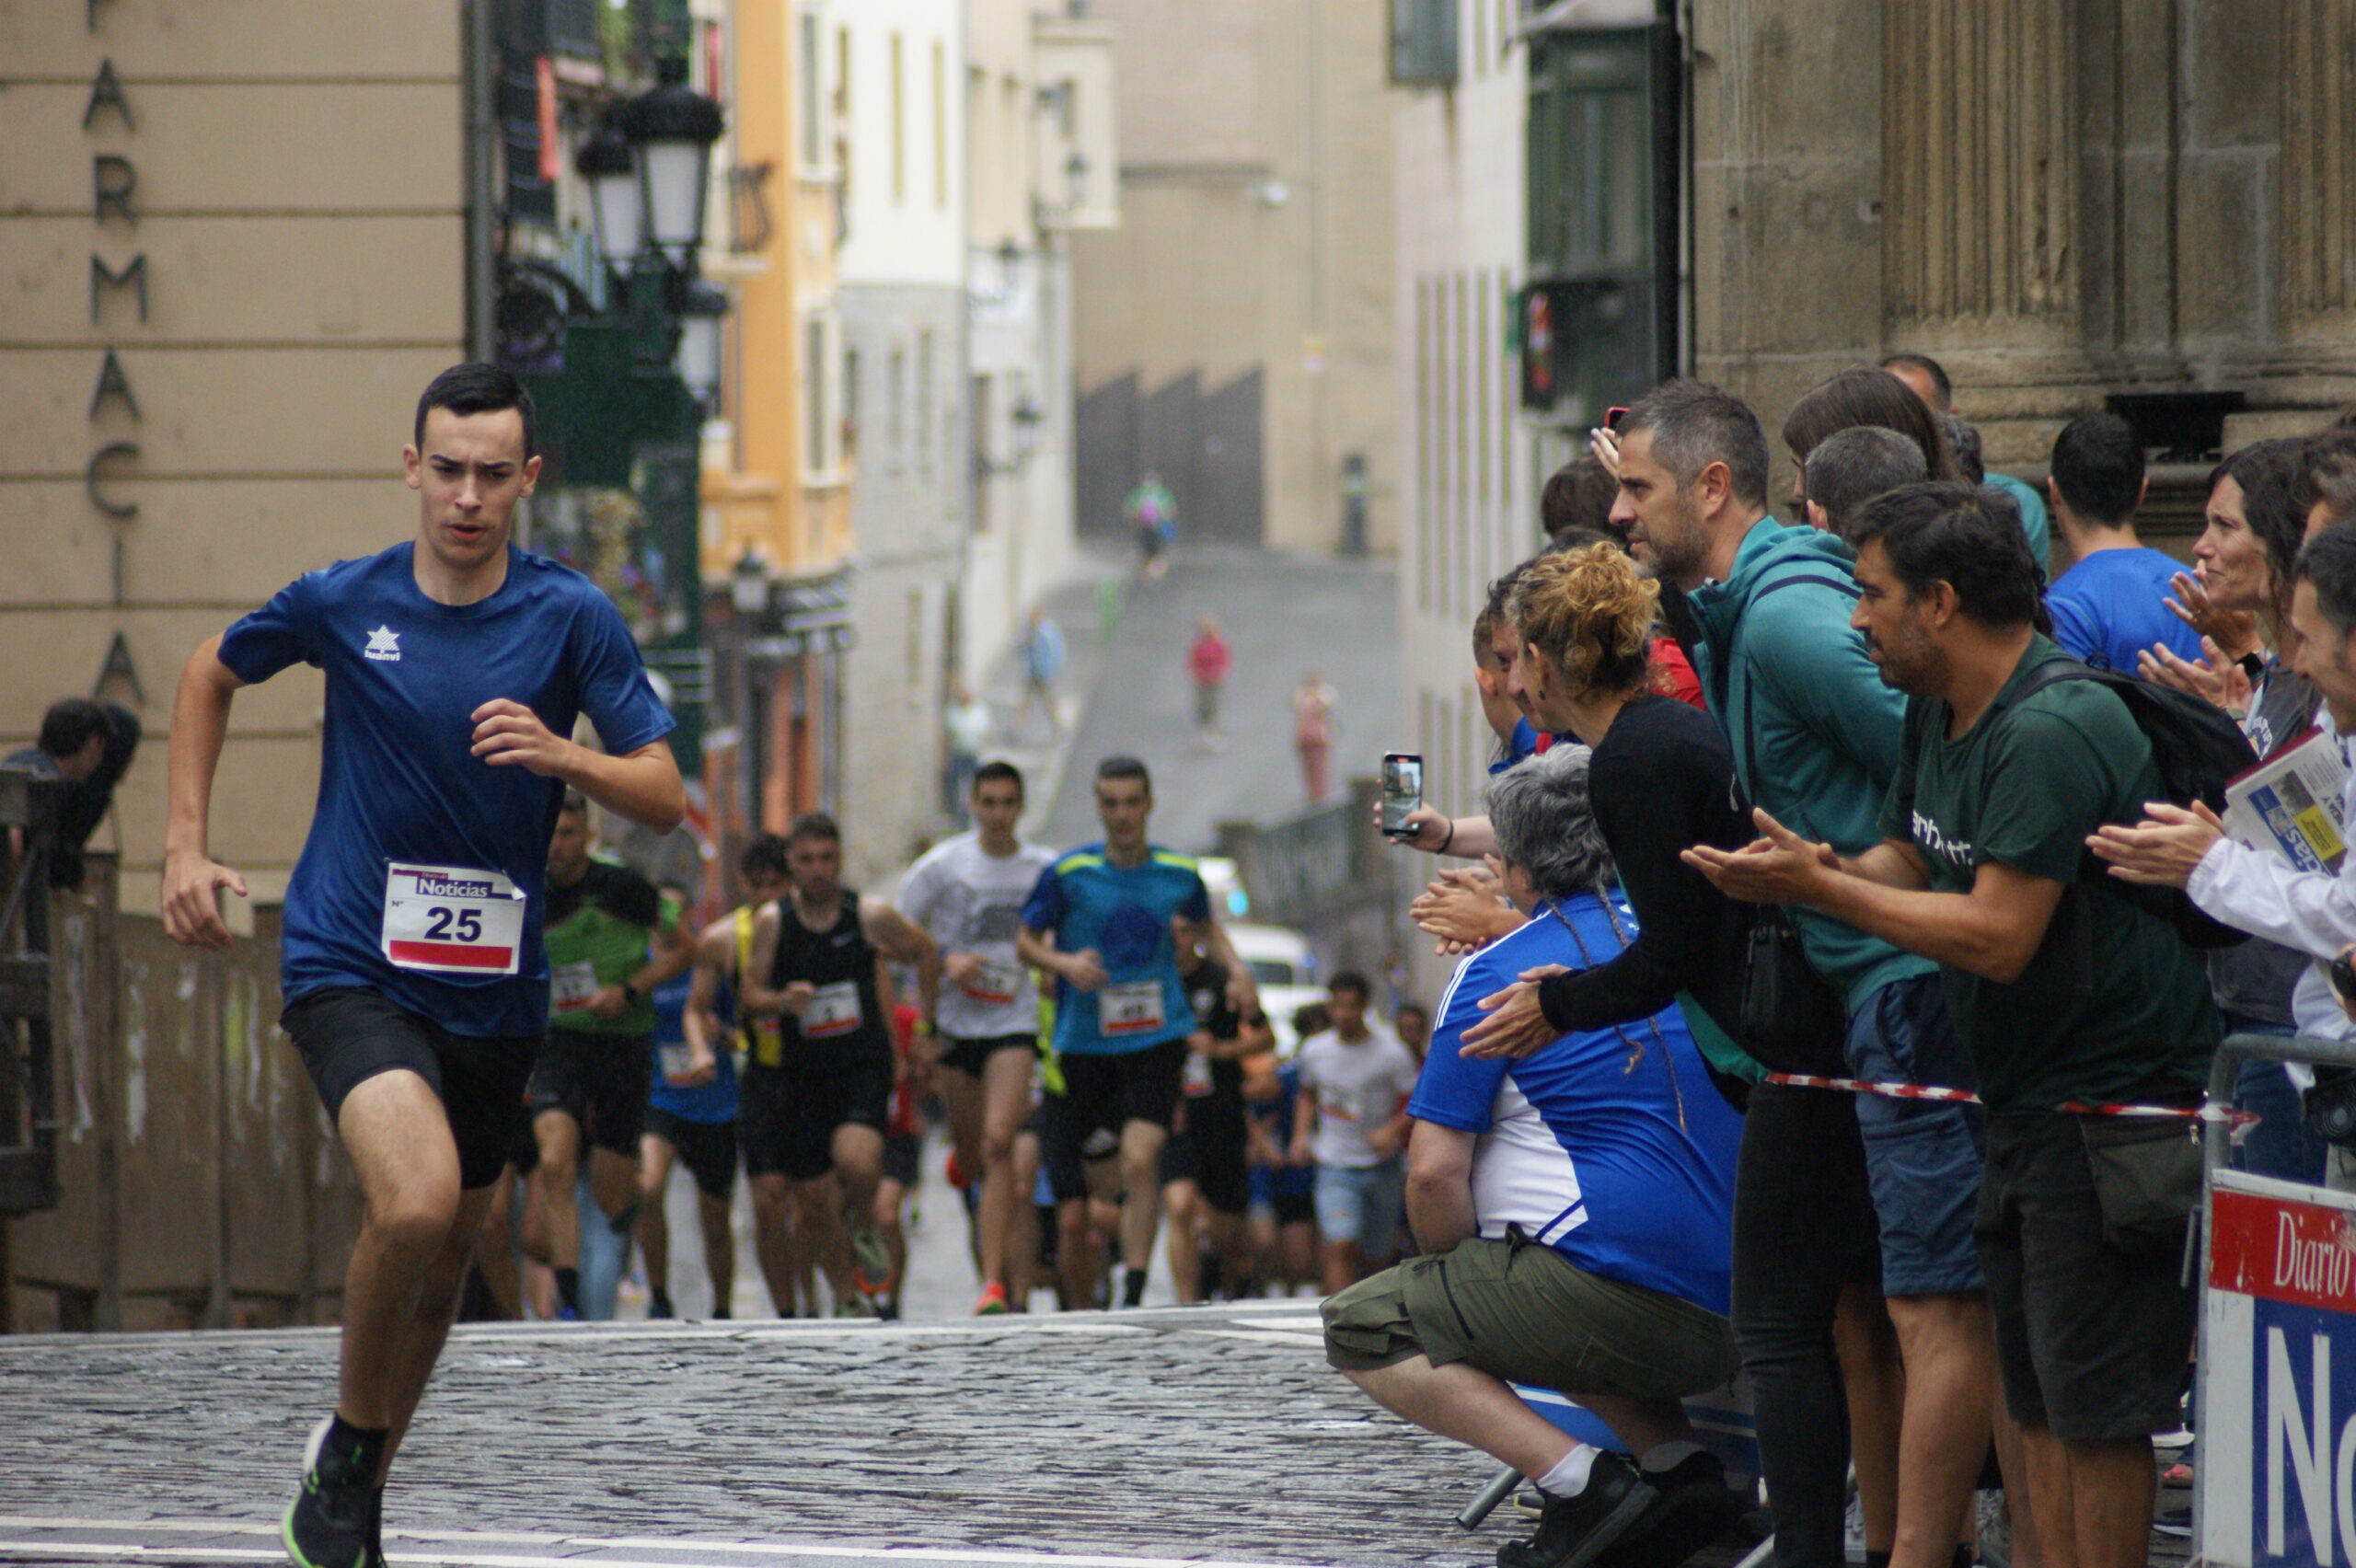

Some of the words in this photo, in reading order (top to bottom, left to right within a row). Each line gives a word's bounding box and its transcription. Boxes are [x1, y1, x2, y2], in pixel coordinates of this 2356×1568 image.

[419, 879, 488, 897] Noticias
[423, 906, 482, 942] 25
[2274, 1210, 2350, 1298] Diario
